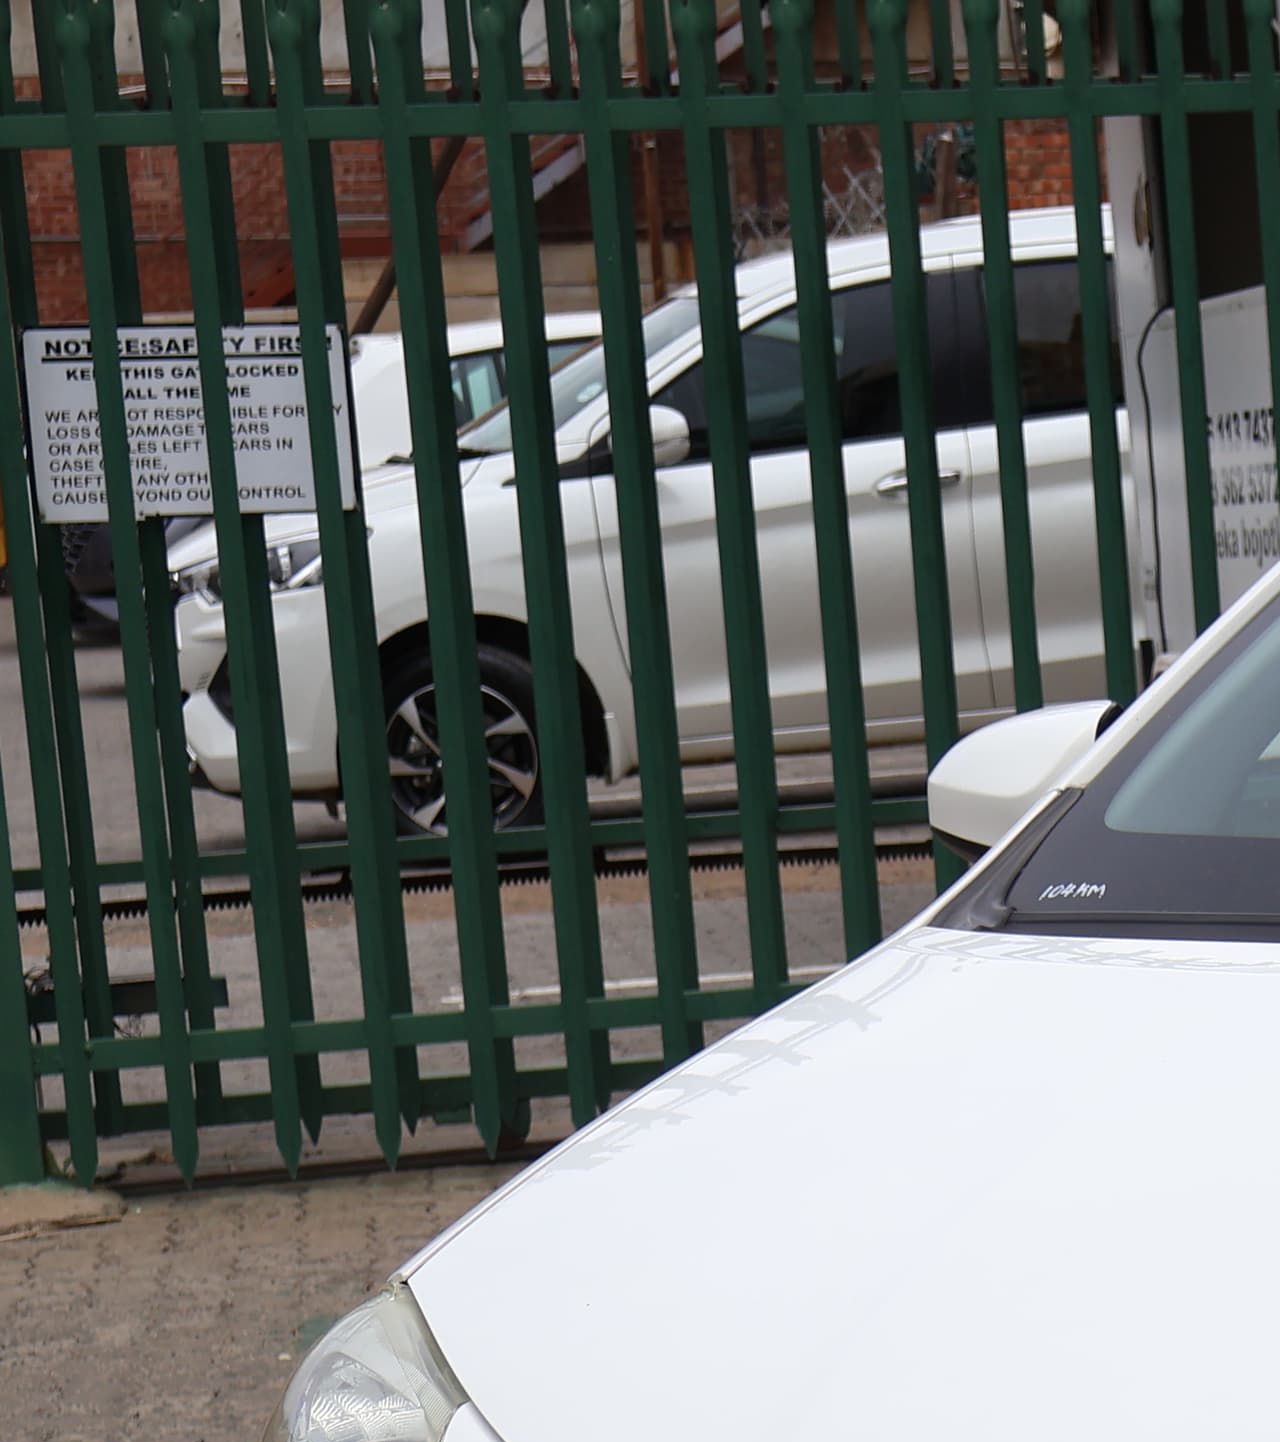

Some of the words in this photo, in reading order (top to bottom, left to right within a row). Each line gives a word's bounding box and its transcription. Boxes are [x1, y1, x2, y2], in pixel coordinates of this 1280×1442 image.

[66, 368, 96, 381] KE
[122, 367, 164, 380] THIS
[171, 366, 199, 379] GA
[124, 387, 157, 400] ALL
[163, 387, 200, 399] THE
[45, 410, 71, 423] WE
[77, 410, 99, 422] AR
[127, 409, 150, 422] OT
[154, 407, 268, 422] RESPOIBLE
[273, 406, 305, 418] FOR
[47, 427, 90, 440] LOSS
[49, 444, 72, 457] OR
[163, 440, 200, 453] LEFT
[277, 438, 293, 450] IN
[50, 460, 92, 473] CASE
[51, 475, 104, 489] THEFT
[137, 473, 170, 486] ANY
[175, 473, 208, 486] OTH
[136, 489, 182, 502] YOND
[187, 489, 211, 502] OU
[240, 486, 306, 500] ONTROL
